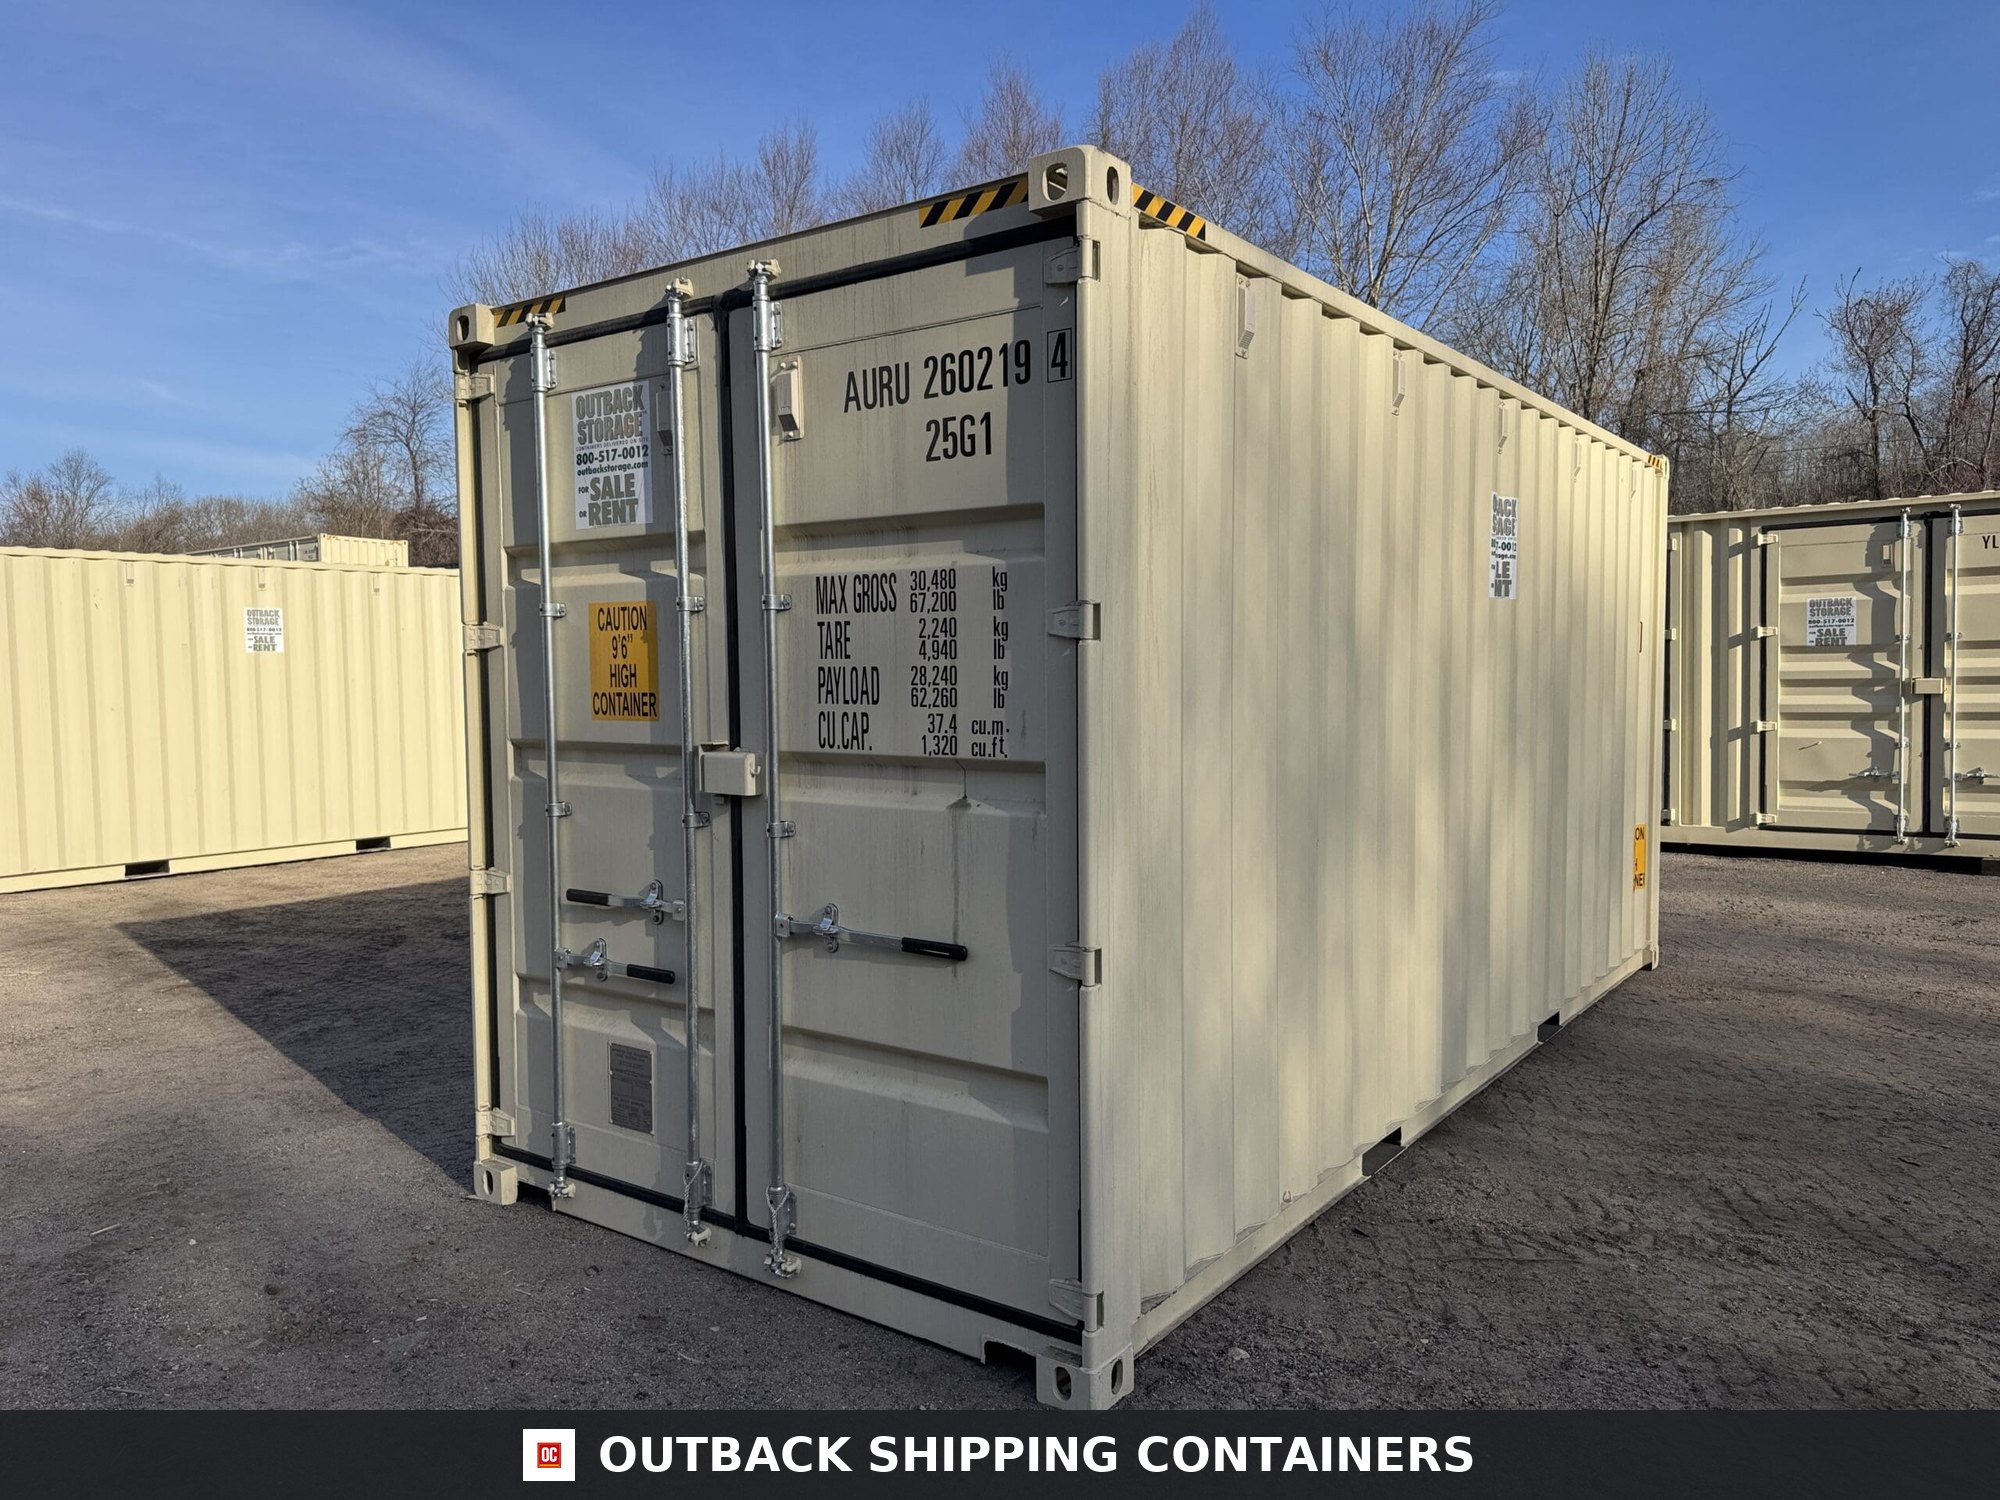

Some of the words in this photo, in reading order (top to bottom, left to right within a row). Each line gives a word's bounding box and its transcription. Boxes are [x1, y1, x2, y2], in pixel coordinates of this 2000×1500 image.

[844, 362, 910, 413] AURU
[924, 340, 1031, 400] 260219
[1050, 332, 1068, 378] 4
[576, 384, 645, 420] OUTBACK
[577, 412, 642, 446] STORAGE
[926, 412, 992, 462] 25G1
[576, 444, 648, 466] 800-517-0012
[604, 439, 628, 448] DELIVERED
[577, 461, 648, 476] outbackstorage.com
[579, 486, 589, 494] FOR
[590, 473, 636, 501] SALE
[579, 510, 587, 518] OR
[588, 498, 638, 526] RENT
[816, 574, 848, 614] MAX
[853, 572, 897, 613] GROSS
[910, 568, 956, 592] 30,480
[992, 566, 1008, 592] kg
[910, 590, 956, 614] 67,200
[993, 589, 1004, 610] lb
[1809, 598, 1852, 608] OUTBACK
[1810, 607, 1851, 617] STORAGE
[598, 606, 647, 631] CAUTION
[817, 621, 851, 659] TARE
[919, 617, 956, 640] 2,240
[993, 616, 1008, 641] kg
[1815, 637, 1847, 646] RENT
[1817, 628, 1846, 637] SALE
[919, 639, 957, 661] 4,940
[993, 639, 1005, 659] lb
[610, 664, 637, 688] HIGH
[818, 666, 880, 705] PAYLOAD
[910, 665, 957, 688] 28,240
[993, 665, 1008, 691] kg
[592, 692, 657, 717] CONTAINER
[911, 688, 957, 709] 62,260
[993, 688, 1004, 708] lb
[818, 711, 872, 751] CU.CAP.
[928, 714, 957, 734] 37.4
[971, 719, 1010, 735] cu.m.
[921, 735, 958, 756] 1,320
[971, 736, 1008, 758] cu.ft.
